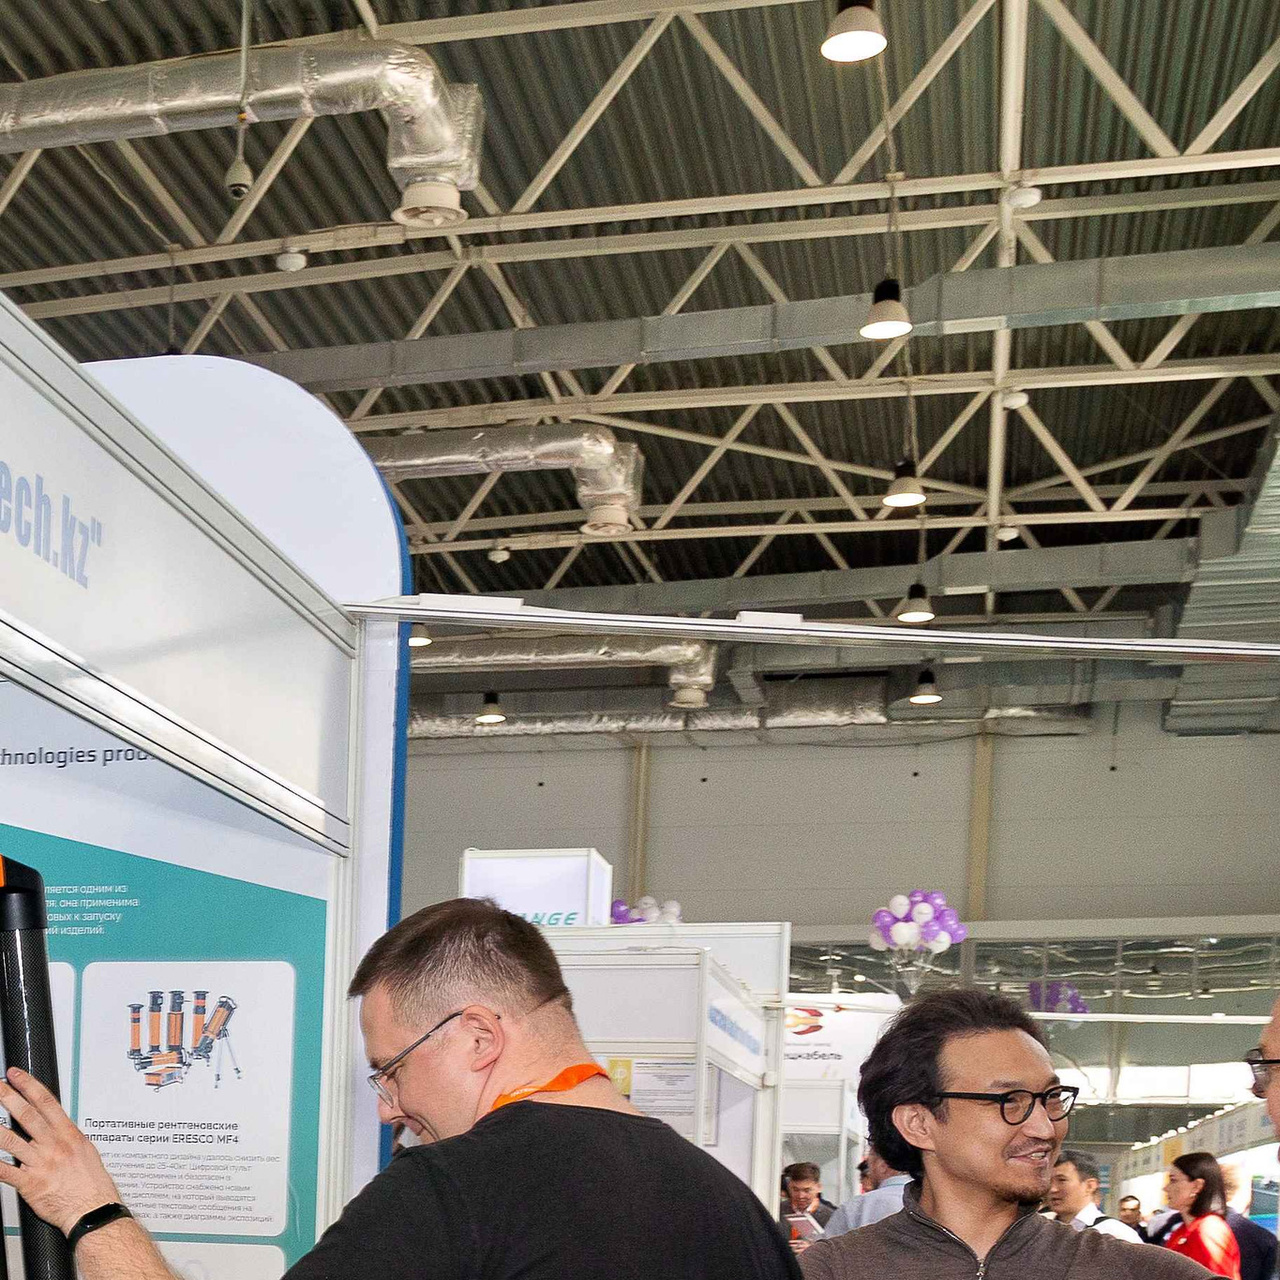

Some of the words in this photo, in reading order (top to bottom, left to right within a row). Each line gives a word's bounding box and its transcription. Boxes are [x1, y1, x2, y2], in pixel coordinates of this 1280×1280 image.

[79, 884, 113, 897] одним
[79, 896, 139, 909] применима
[82, 911, 121, 925] запуску
[85, 1118, 156, 1130] Портативные
[157, 1120, 239, 1132] рентгеновские
[84, 1132, 135, 1144] аппараты
[136, 1134, 170, 1145] серии
[172, 1133, 214, 1144] ERESCO
[216, 1134, 239, 1144] MF4
[140, 1181, 185, 1191] Устройство
[182, 1193, 215, 1202] который
